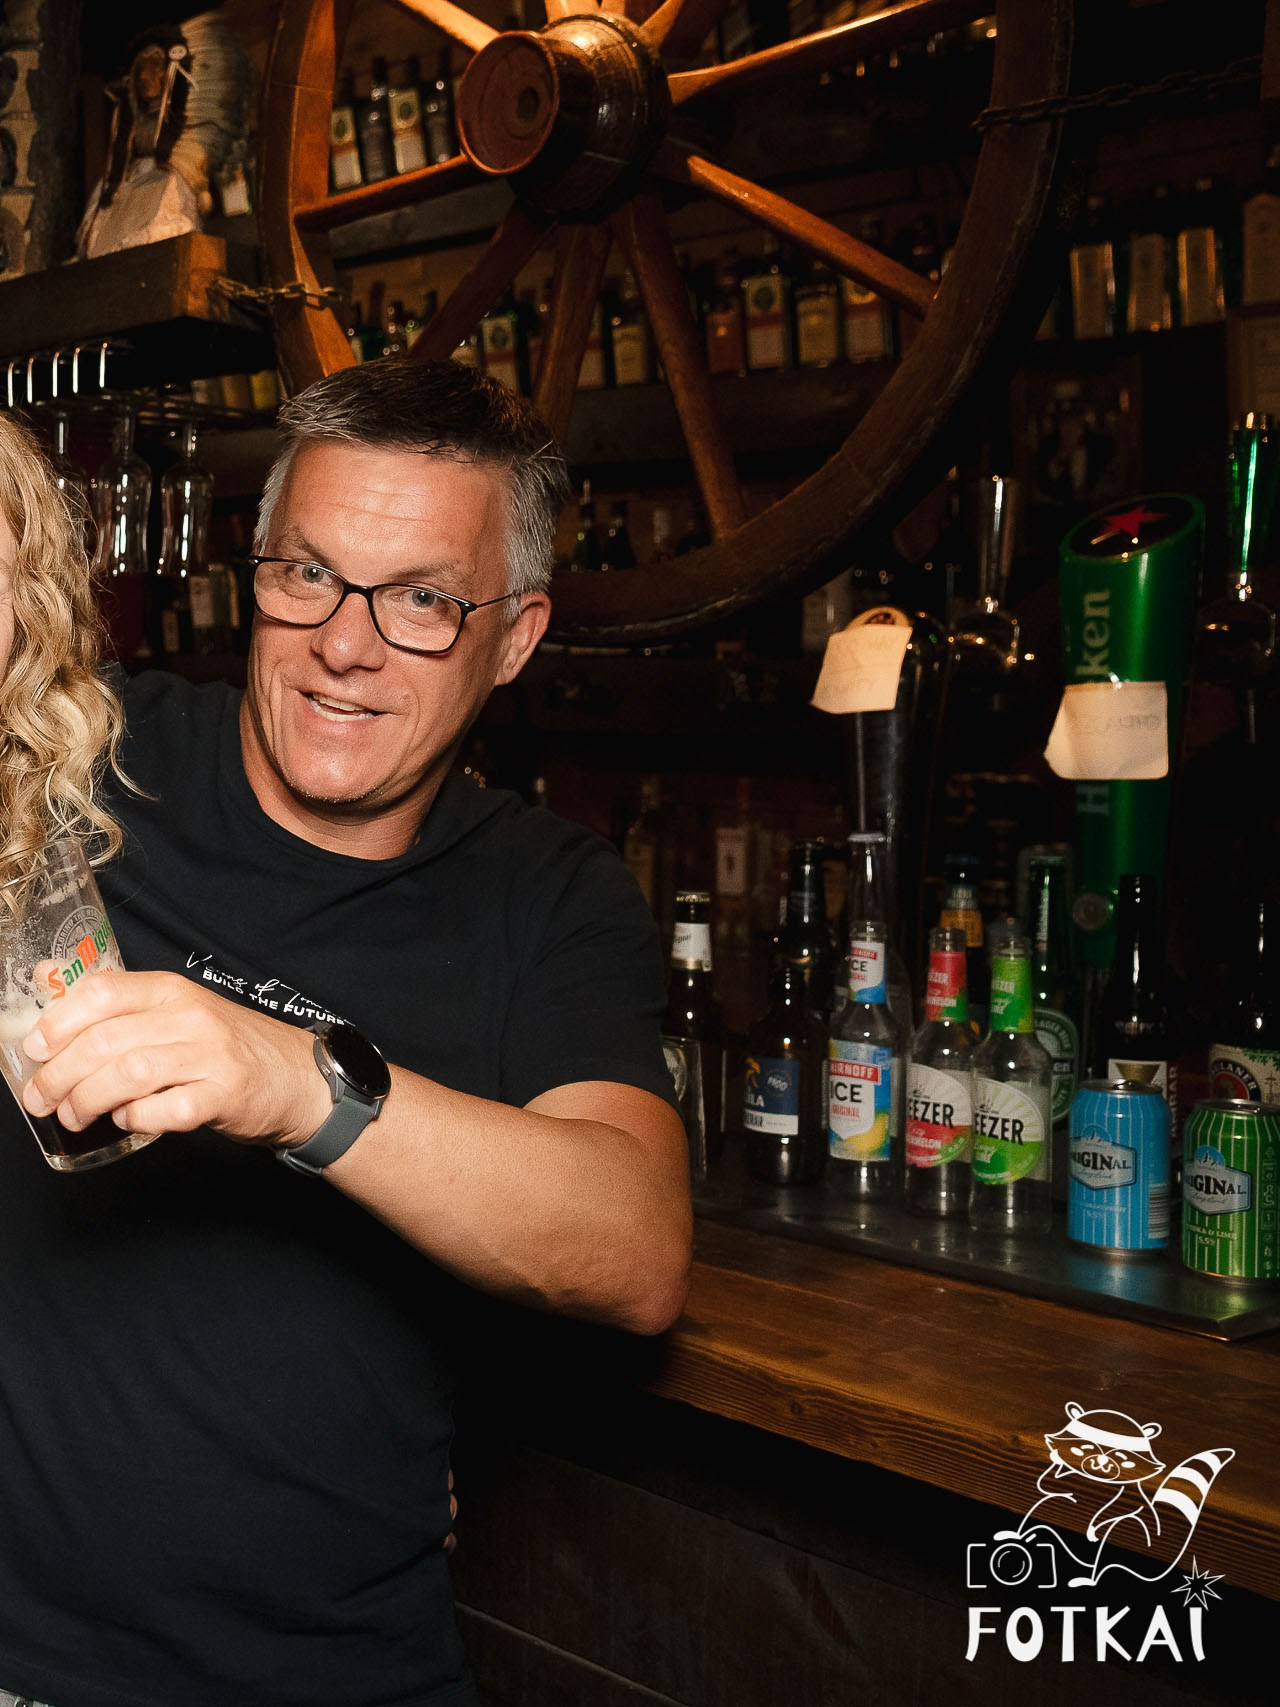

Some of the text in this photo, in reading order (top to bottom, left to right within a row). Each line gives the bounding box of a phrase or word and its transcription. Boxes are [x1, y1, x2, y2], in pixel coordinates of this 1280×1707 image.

[202, 969, 244, 994] BUILD
[249, 992, 279, 1010] THE
[830, 1081, 863, 1103] ICE
